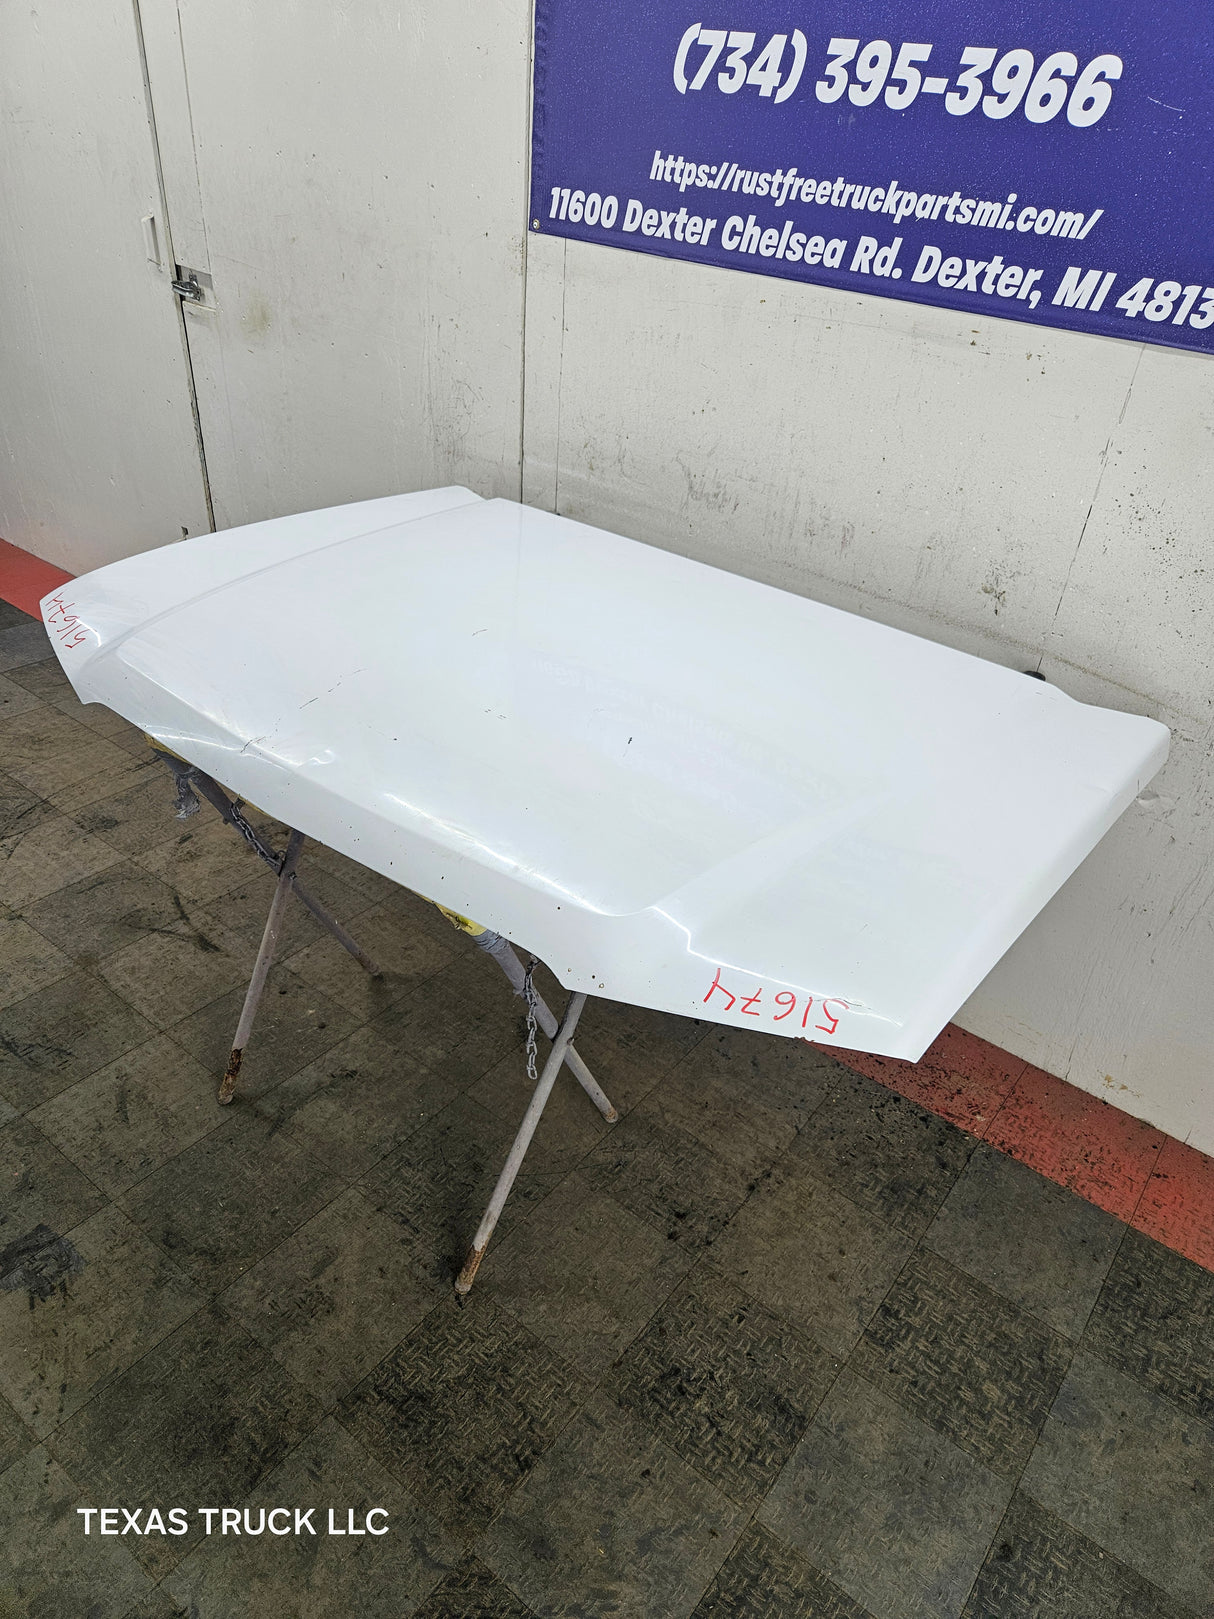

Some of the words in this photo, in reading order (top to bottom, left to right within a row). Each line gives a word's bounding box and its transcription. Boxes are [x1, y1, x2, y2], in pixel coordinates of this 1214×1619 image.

[673, 22, 808, 104] (734)
[815, 38, 1123, 127] 395-3966
[649, 150, 1104, 241] https://rustfreetruckpartsmi.com/
[549, 186, 618, 229] 11600
[622, 198, 717, 247] Dexter
[720, 214, 848, 269] Chelsea
[850, 236, 904, 280] Rd.
[910, 245, 1043, 309] Dexter,
[1051, 266, 1118, 312] MI
[45, 591, 97, 649] 51674
[703, 967, 850, 1035] 51674
